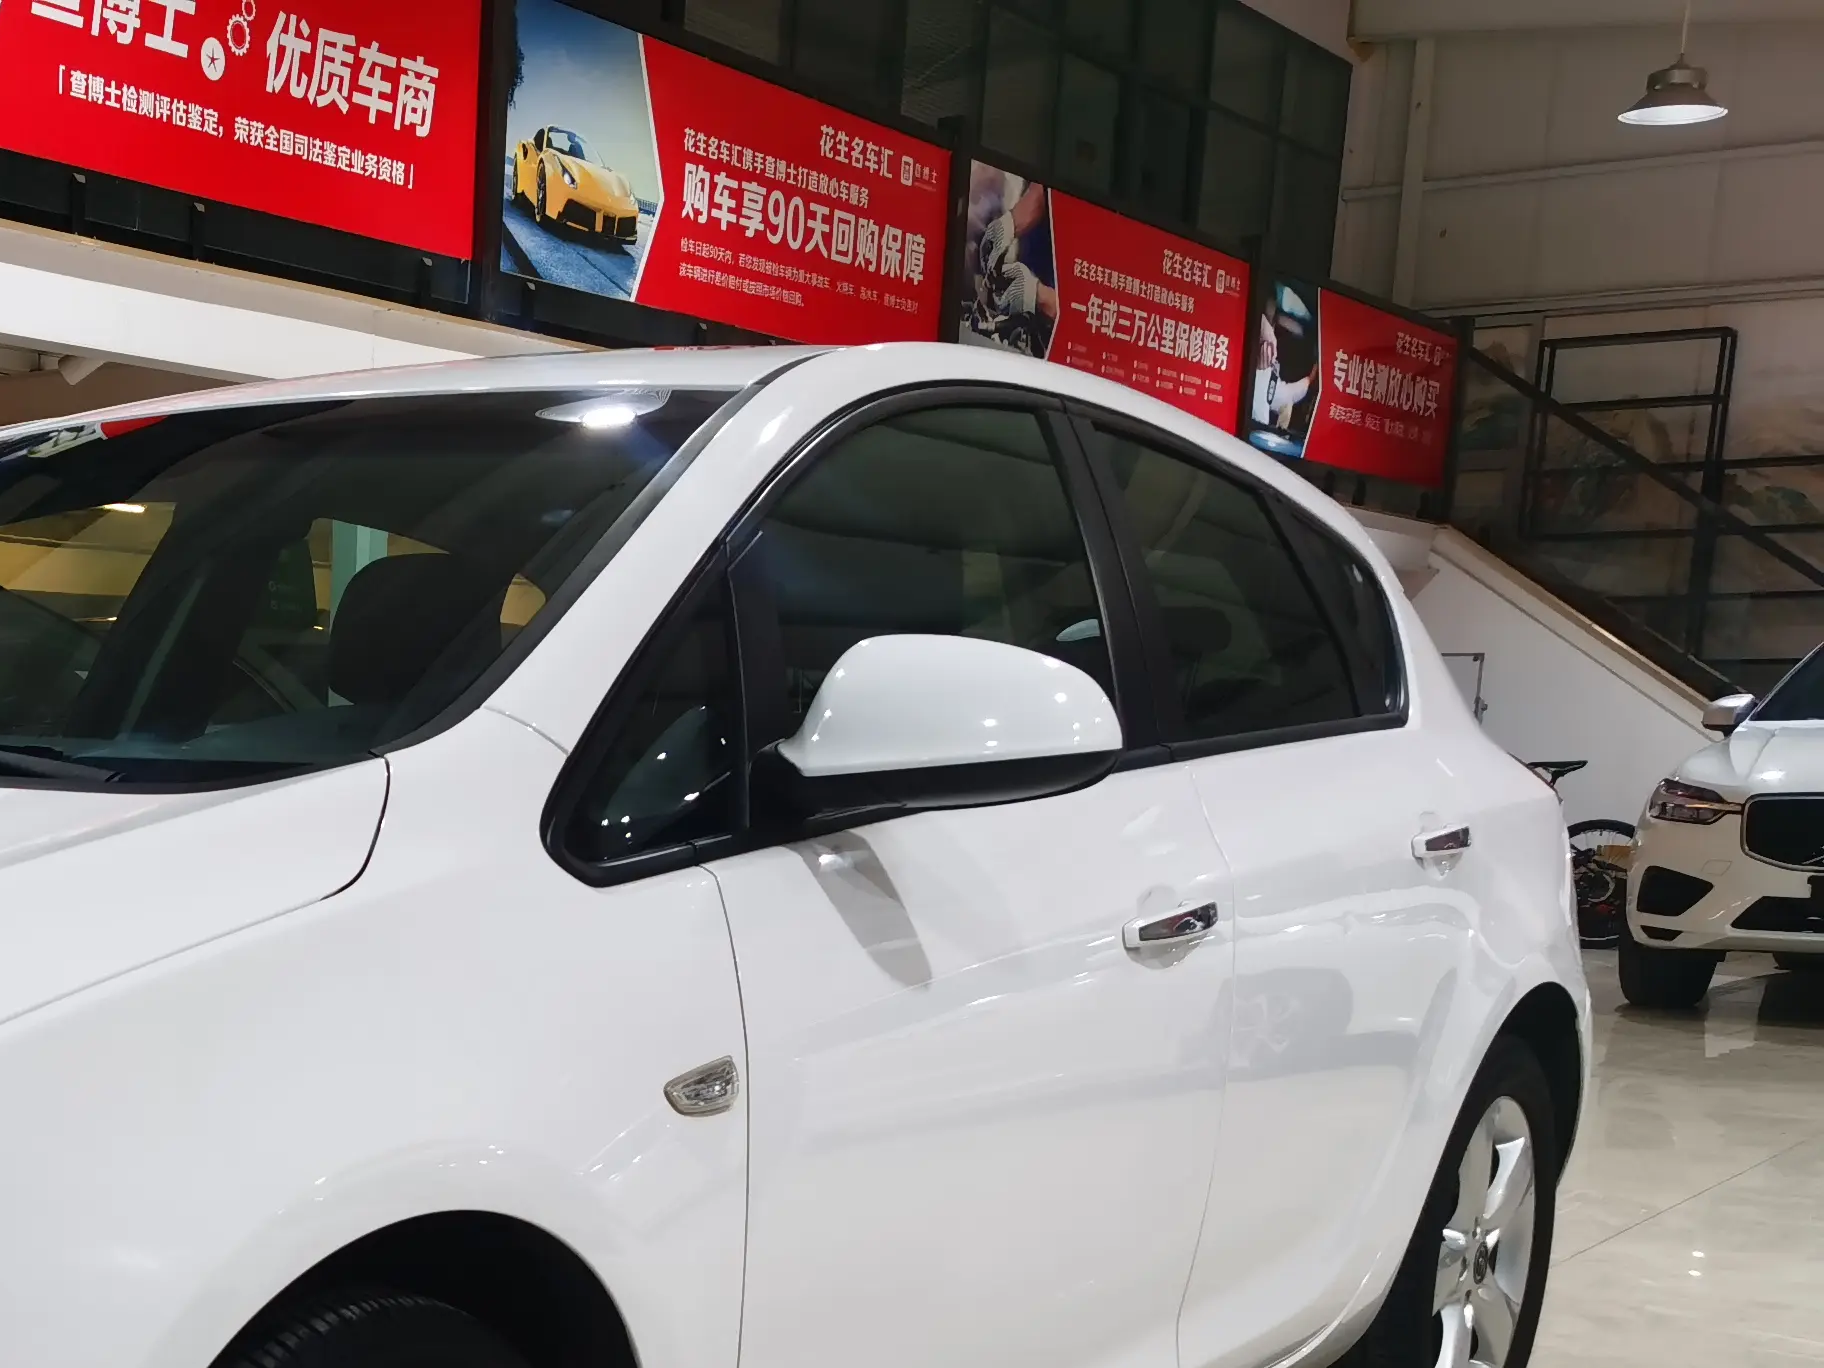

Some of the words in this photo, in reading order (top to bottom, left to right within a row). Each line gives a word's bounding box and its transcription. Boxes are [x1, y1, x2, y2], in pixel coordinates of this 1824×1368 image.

[266, 10, 439, 138] 优质车商
[683, 127, 870, 208] 花生名车汇携手查博士打造放心车服务
[820, 124, 894, 179] 花生名车汇
[681, 163, 927, 286] 购车享90天回购保障
[1162, 248, 1213, 289] 花生名车汇
[1071, 293, 1230, 371] 一年或三万公里保修服务
[1332, 348, 1441, 420] 专业检测放心购买
